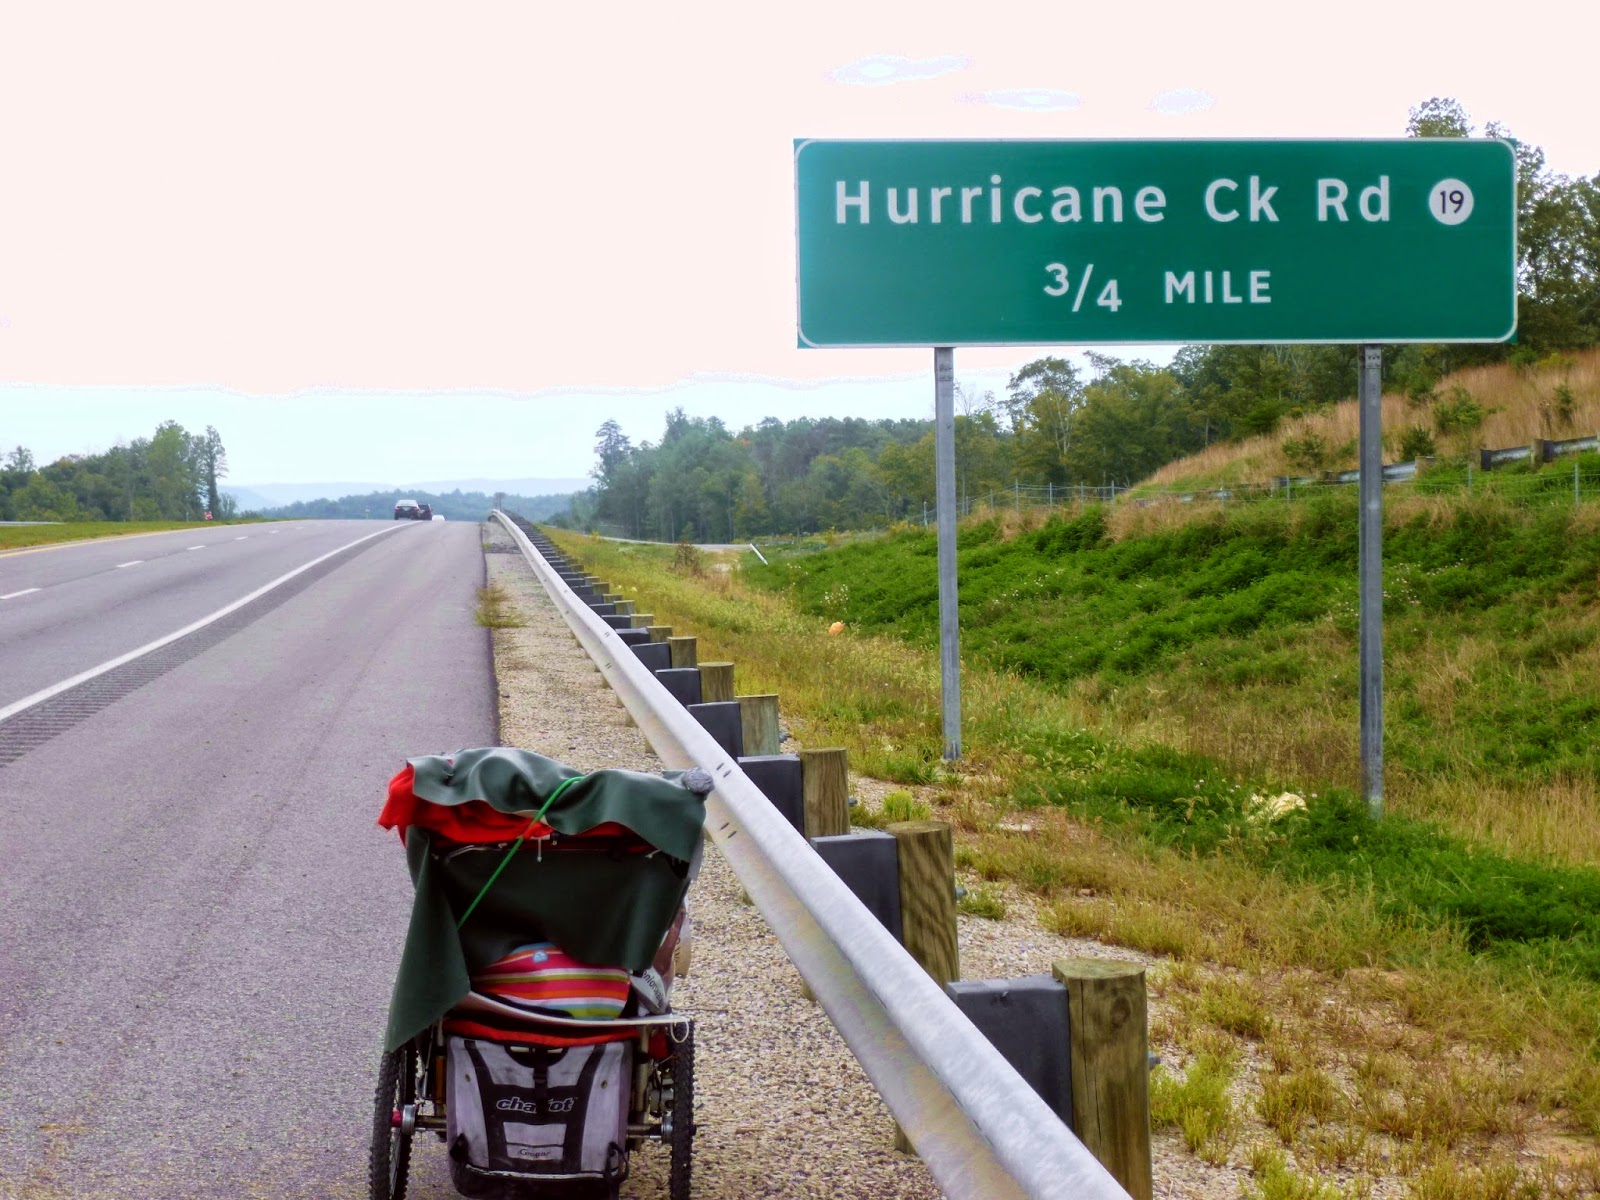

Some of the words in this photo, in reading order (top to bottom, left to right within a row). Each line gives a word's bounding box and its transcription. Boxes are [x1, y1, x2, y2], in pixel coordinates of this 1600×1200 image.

[835, 174, 1167, 224] Hurricane
[1204, 176, 1279, 223] Ck
[1317, 176, 1390, 222] Rd
[1440, 190, 1464, 214] 19
[1043, 263, 1122, 313] 3/4
[1165, 270, 1272, 304] MILE
[496, 1096, 575, 1114] chaot
